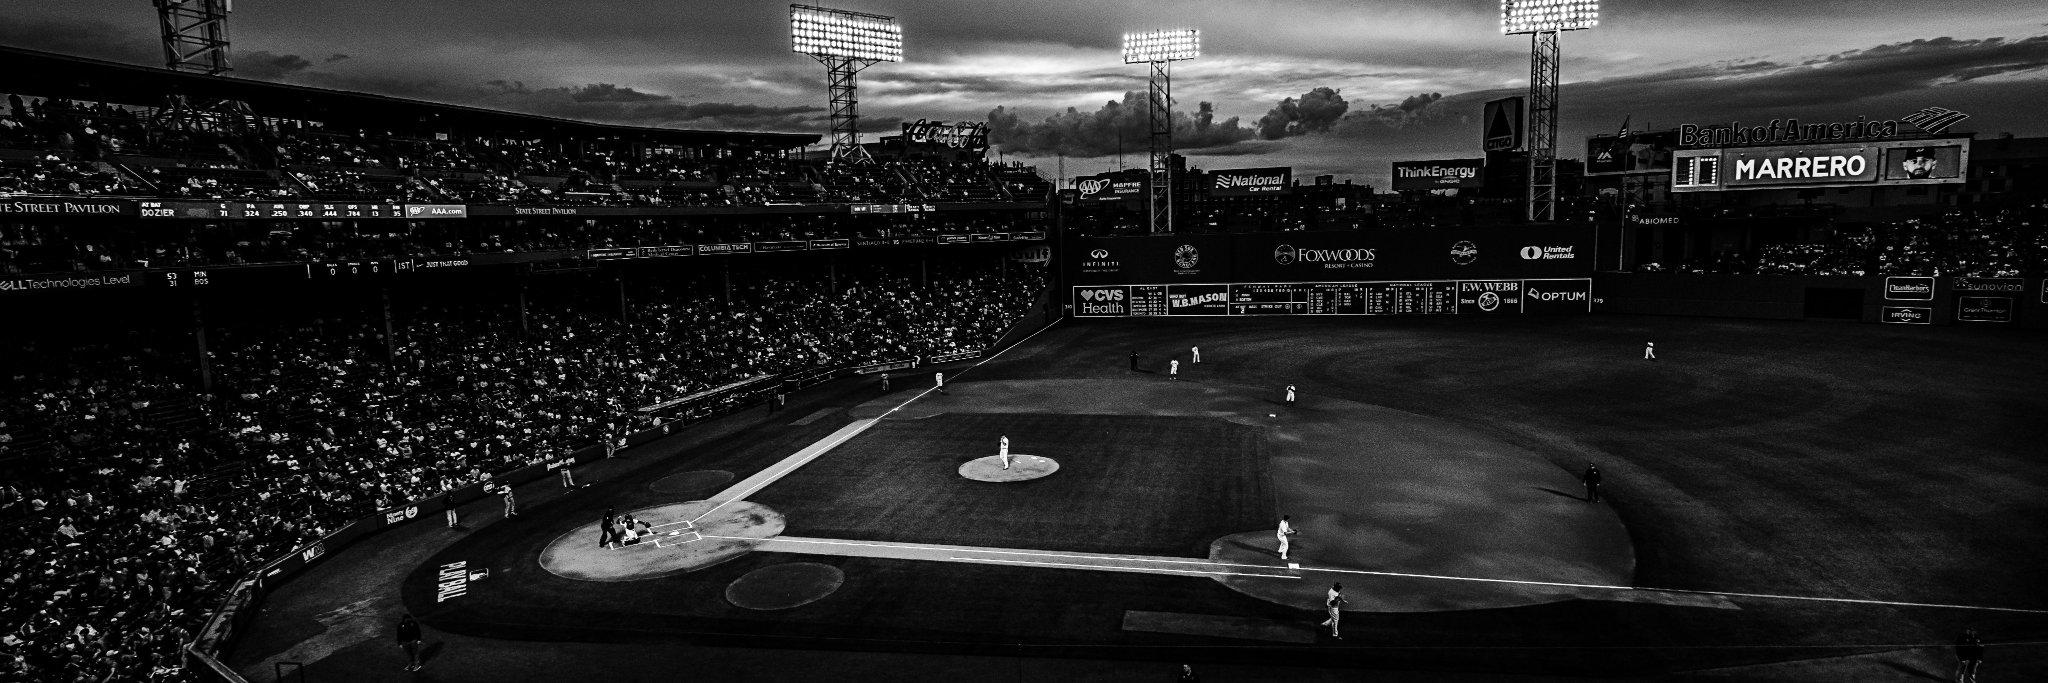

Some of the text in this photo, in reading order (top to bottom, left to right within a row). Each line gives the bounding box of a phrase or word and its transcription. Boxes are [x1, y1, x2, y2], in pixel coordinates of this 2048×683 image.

[906, 118, 990, 149] Coca-Cola
[1680, 116, 1898, 146] Bank of America
[1486, 137, 1512, 150] CITGO
[1397, 165, 1476, 178] ThinkEnergy
[1735, 155, 1866, 181] MARRERO
[1113, 181, 1142, 189] MAPFRE
[1231, 173, 1284, 187] National
[1080, 180, 1101, 194] AAA
[14, 201, 60, 213] STREET
[64, 202, 120, 213] PAVILION
[141, 208, 175, 217] DOZIER
[431, 207, 463, 215] AAA.com
[1639, 217, 1680, 225] ABIOMED
[1298, 248, 1376, 262] FOXWOODS
[1544, 245, 1573, 253] United
[330, 265, 379, 276] 0 0 0
[399, 261, 410, 270] 1ST
[25, 278, 101, 289] Technologies
[103, 274, 131, 285] Level
[166, 272, 178, 280] 53
[1462, 283, 1519, 292] F.W. WEBB
[1967, 282, 2022, 290] sunovion
[1094, 289, 1124, 302] CVS
[1541, 291, 1586, 301] OPTUM
[1082, 302, 1124, 314] Health
